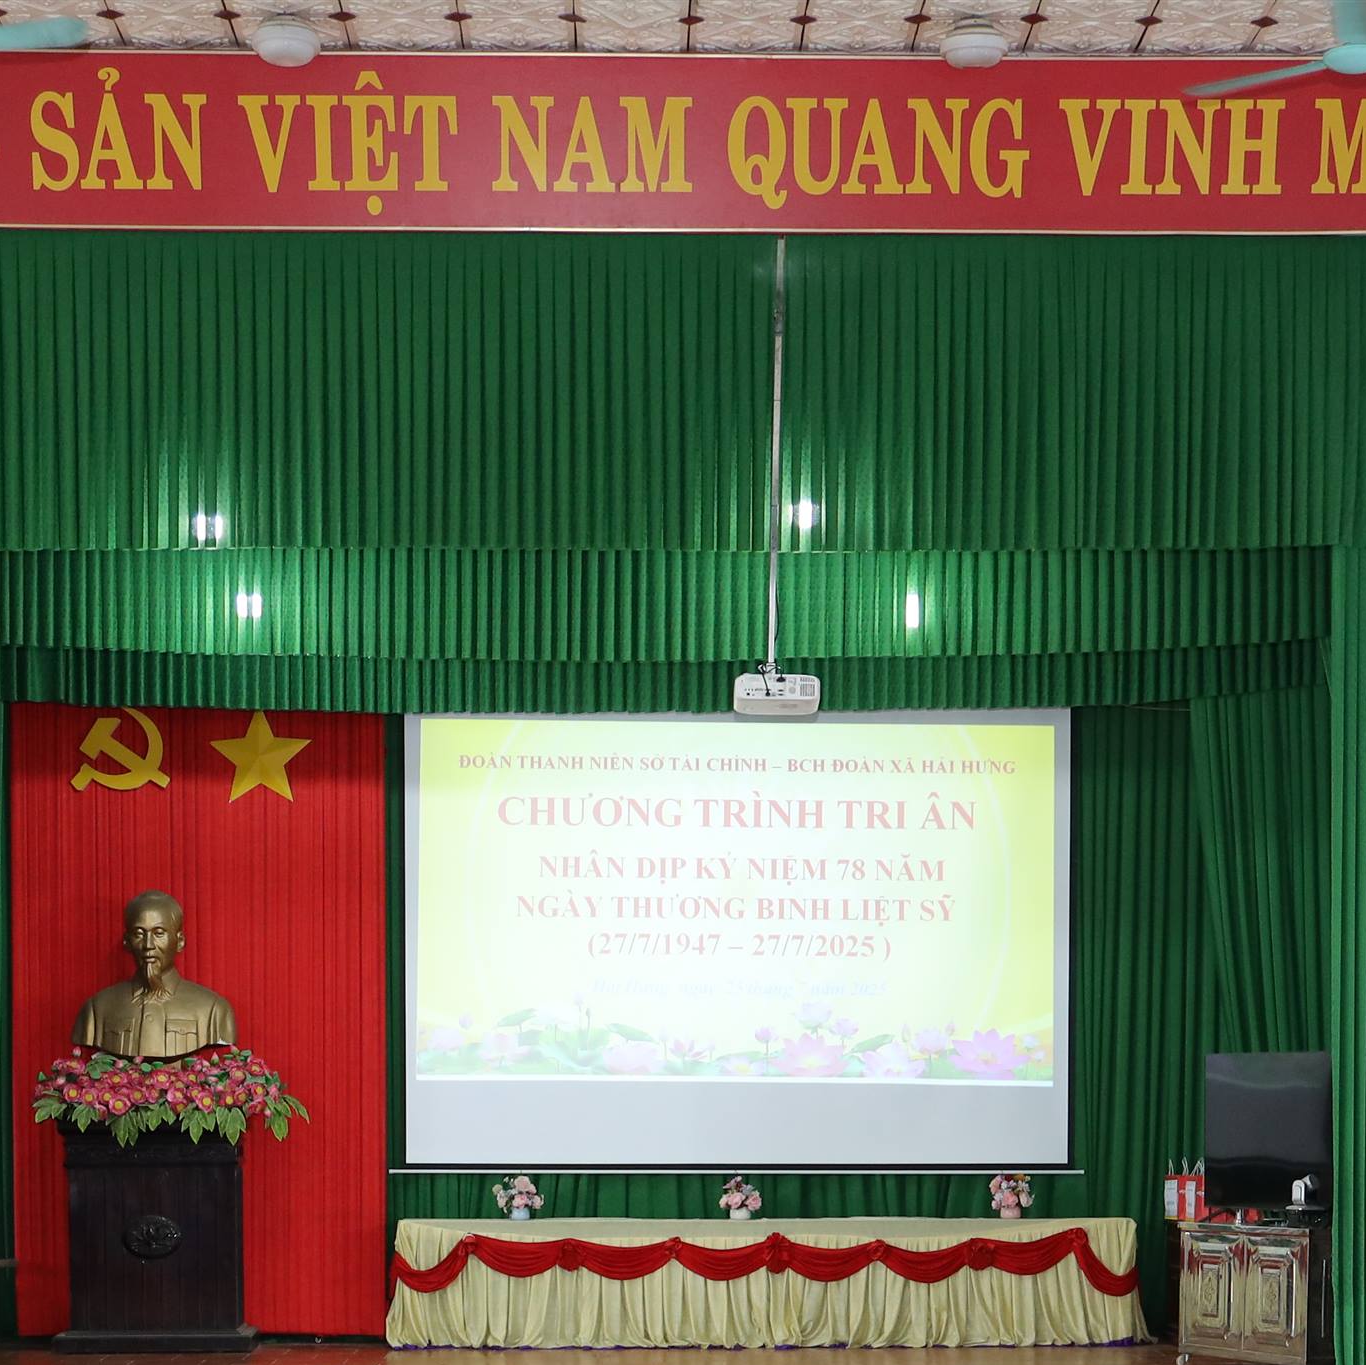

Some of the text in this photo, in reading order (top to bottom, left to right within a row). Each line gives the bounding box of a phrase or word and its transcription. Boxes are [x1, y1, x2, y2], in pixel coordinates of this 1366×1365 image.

[30, 67, 206, 191] SẢN
[236, 71, 464, 216] VIỆT
[492, 94, 690, 194] NAM
[727, 96, 1030, 211] QUANG
[1057, 98, 1286, 197] VINH
[459, 752, 512, 769] ĐOÀN
[517, 755, 584, 770] THANH
[589, 753, 633, 770] NIÊN
[668, 754, 700, 771] TÀI
[706, 754, 767, 772] CHÍNH
[787, 758, 825, 773] BCH
[831, 756, 885, 773] ĐOÀN
[890, 757, 915, 773] XÃ
[961, 758, 1016, 775] HƯNG
[498, 790, 977, 830] CHƯƠNG TRÌNH TRI ÂN
[539, 849, 625, 878] NHÂN
[636, 856, 687, 884] DỊP
[747, 854, 827, 886] NIỆM
[837, 858, 866, 881] 78
[875, 853, 945, 882] NĂM
[516, 889, 601, 918] NGÀY
[611, 893, 745, 920] THƯƠNG
[756, 898, 830, 921] BINH
[841, 896, 912, 927] LIỆT
[588, 932, 721, 959] (27/7/1947
[752, 934, 875, 958] 27/7/2025
